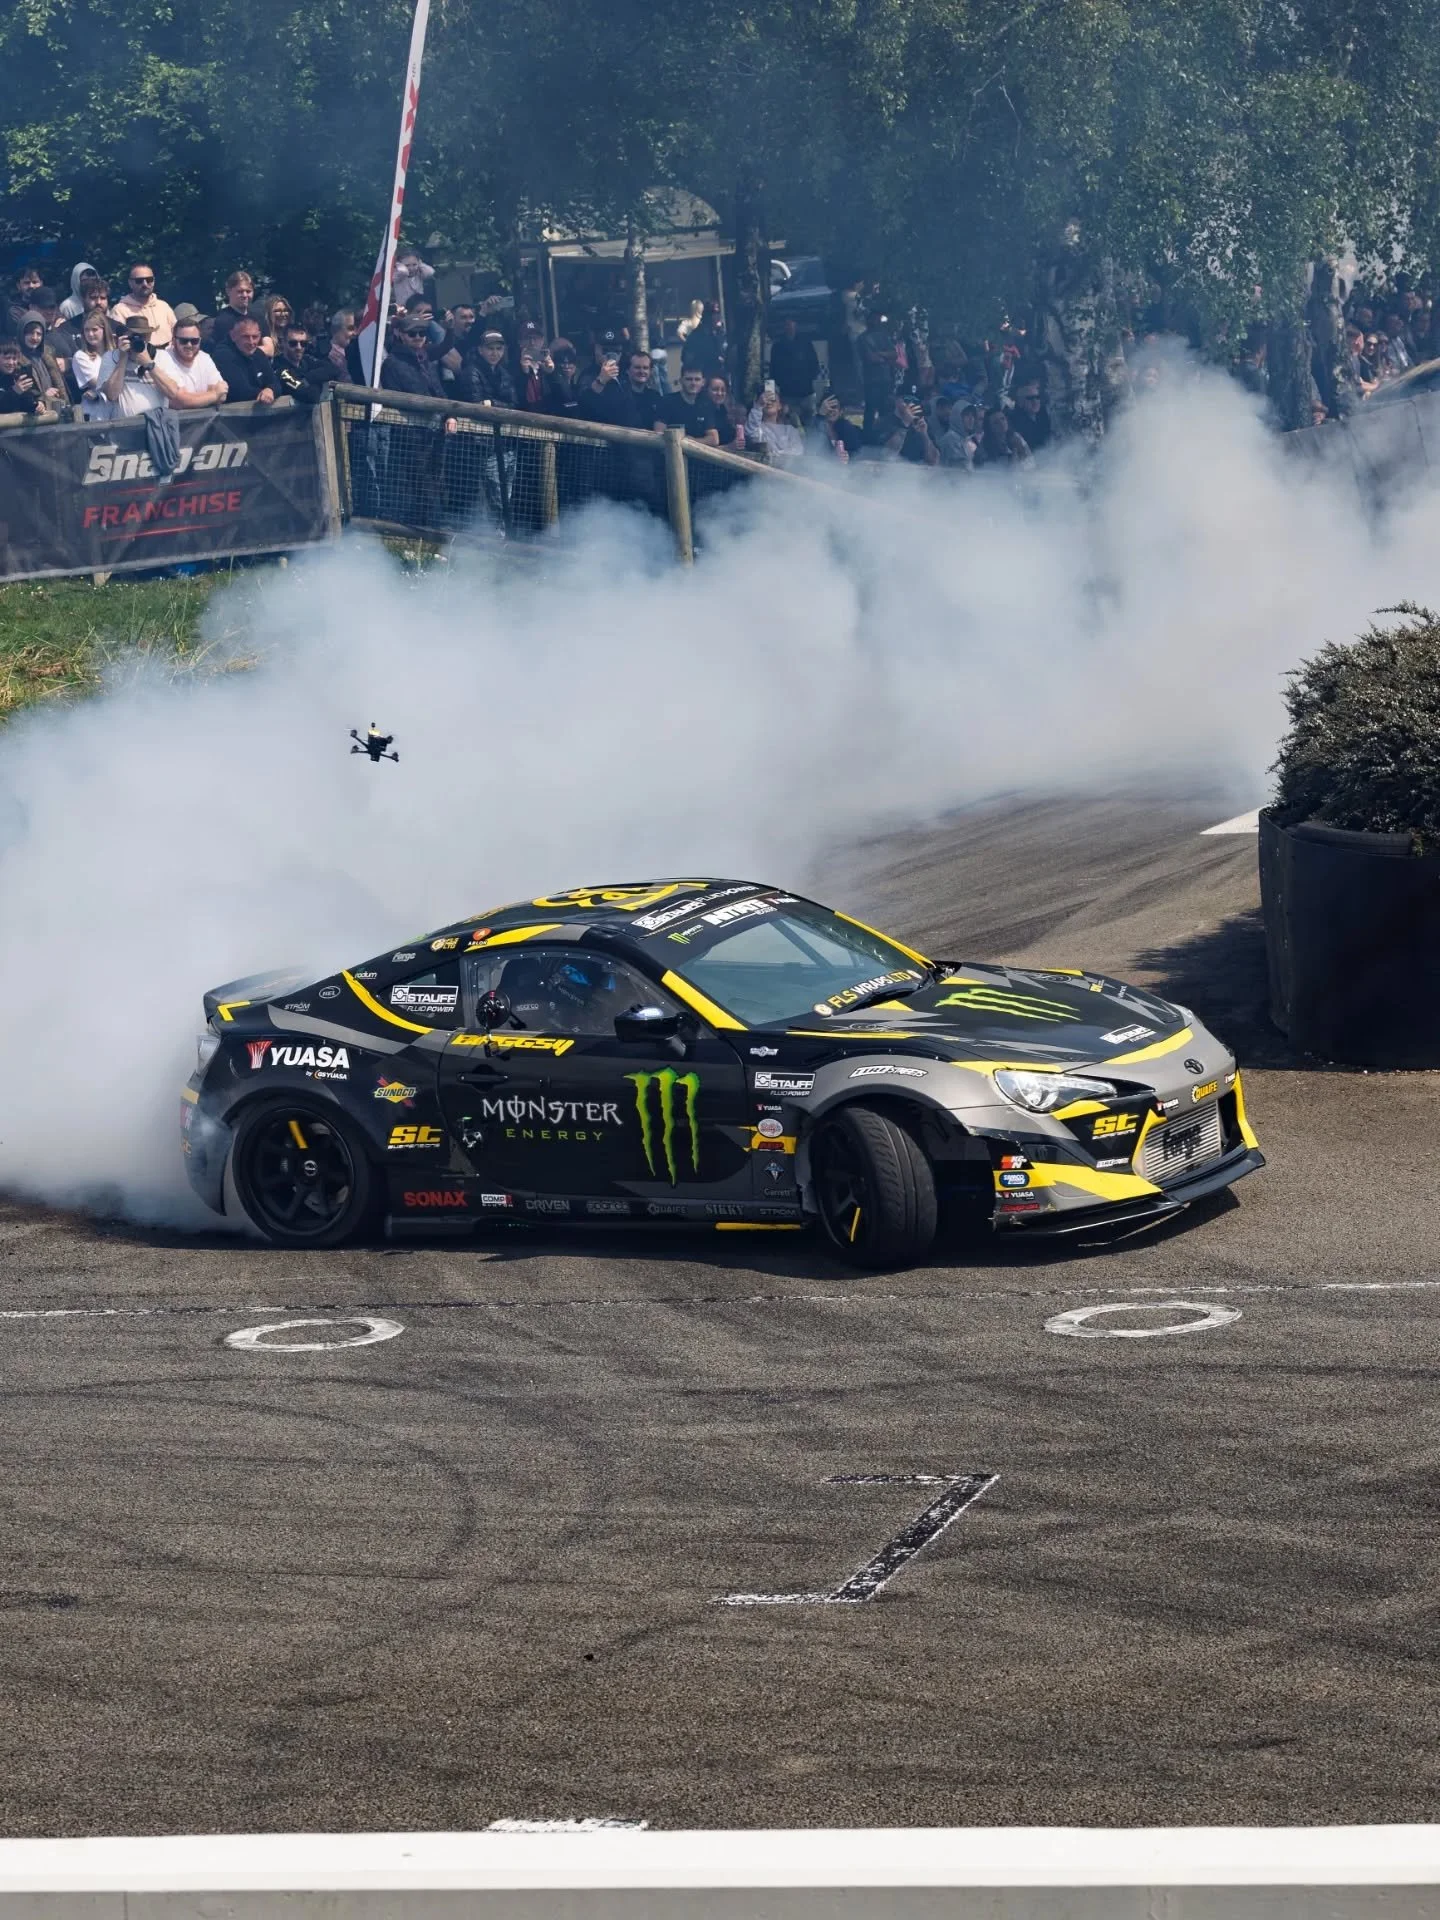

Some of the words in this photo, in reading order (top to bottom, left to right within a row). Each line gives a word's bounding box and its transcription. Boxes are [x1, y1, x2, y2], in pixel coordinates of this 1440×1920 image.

[83, 491, 241, 528] FRANCHISE
[827, 990, 858, 1008] FLS
[850, 975, 893, 995] WRAPS
[891, 971, 912, 983] LTD
[406, 994, 456, 1004] STAUFF
[270, 1047, 350, 1069] YUASA
[771, 1080, 813, 1088] STAUFF
[376, 1088, 414, 1097] SUNOCO
[482, 1096, 623, 1125] MONSTER
[506, 1128, 603, 1141] ENERGY
[404, 1192, 468, 1207] SONAX
[526, 1200, 570, 1212] DRIVEN
